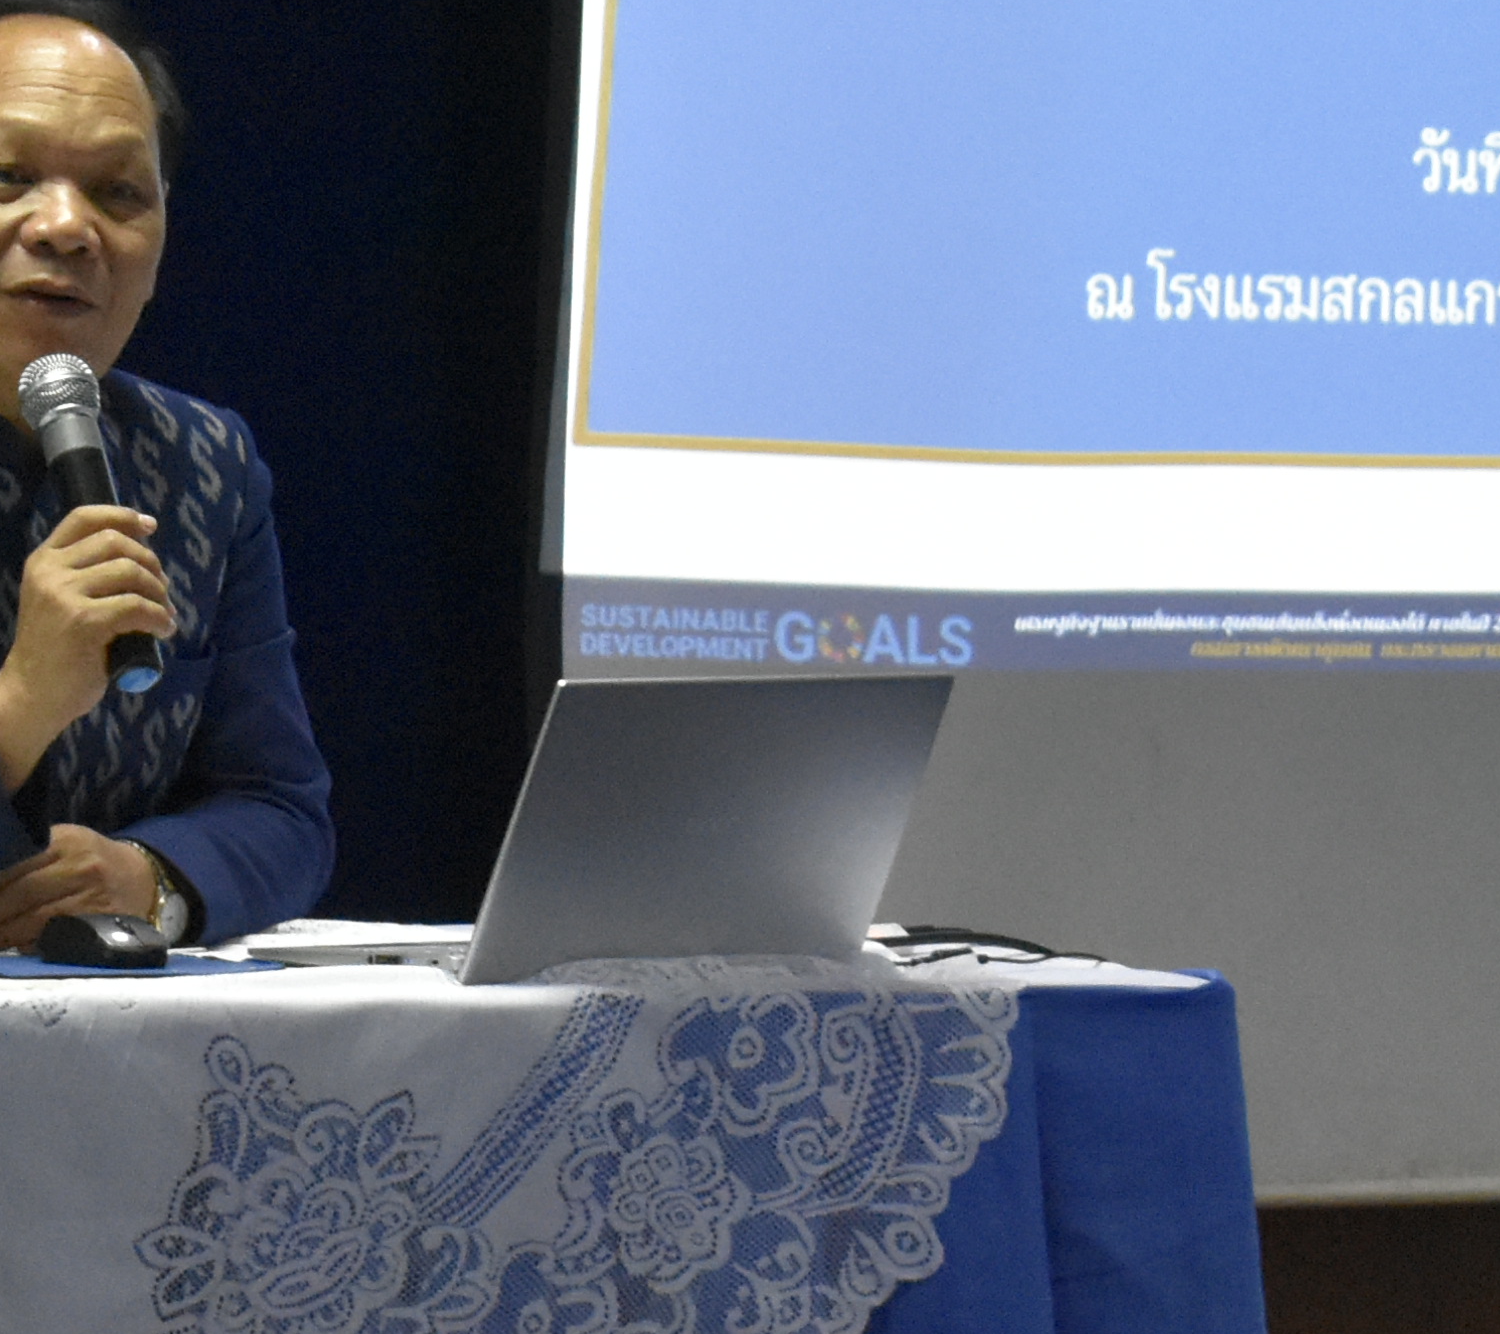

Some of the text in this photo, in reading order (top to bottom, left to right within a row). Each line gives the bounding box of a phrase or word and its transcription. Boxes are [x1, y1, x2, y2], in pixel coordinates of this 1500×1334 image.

[1086, 273, 1135, 321] ณ
[579, 603, 769, 634] SUSTAINABLE
[774, 610, 975, 666] GOALS
[579, 632, 769, 663] DEVELOPMENT
